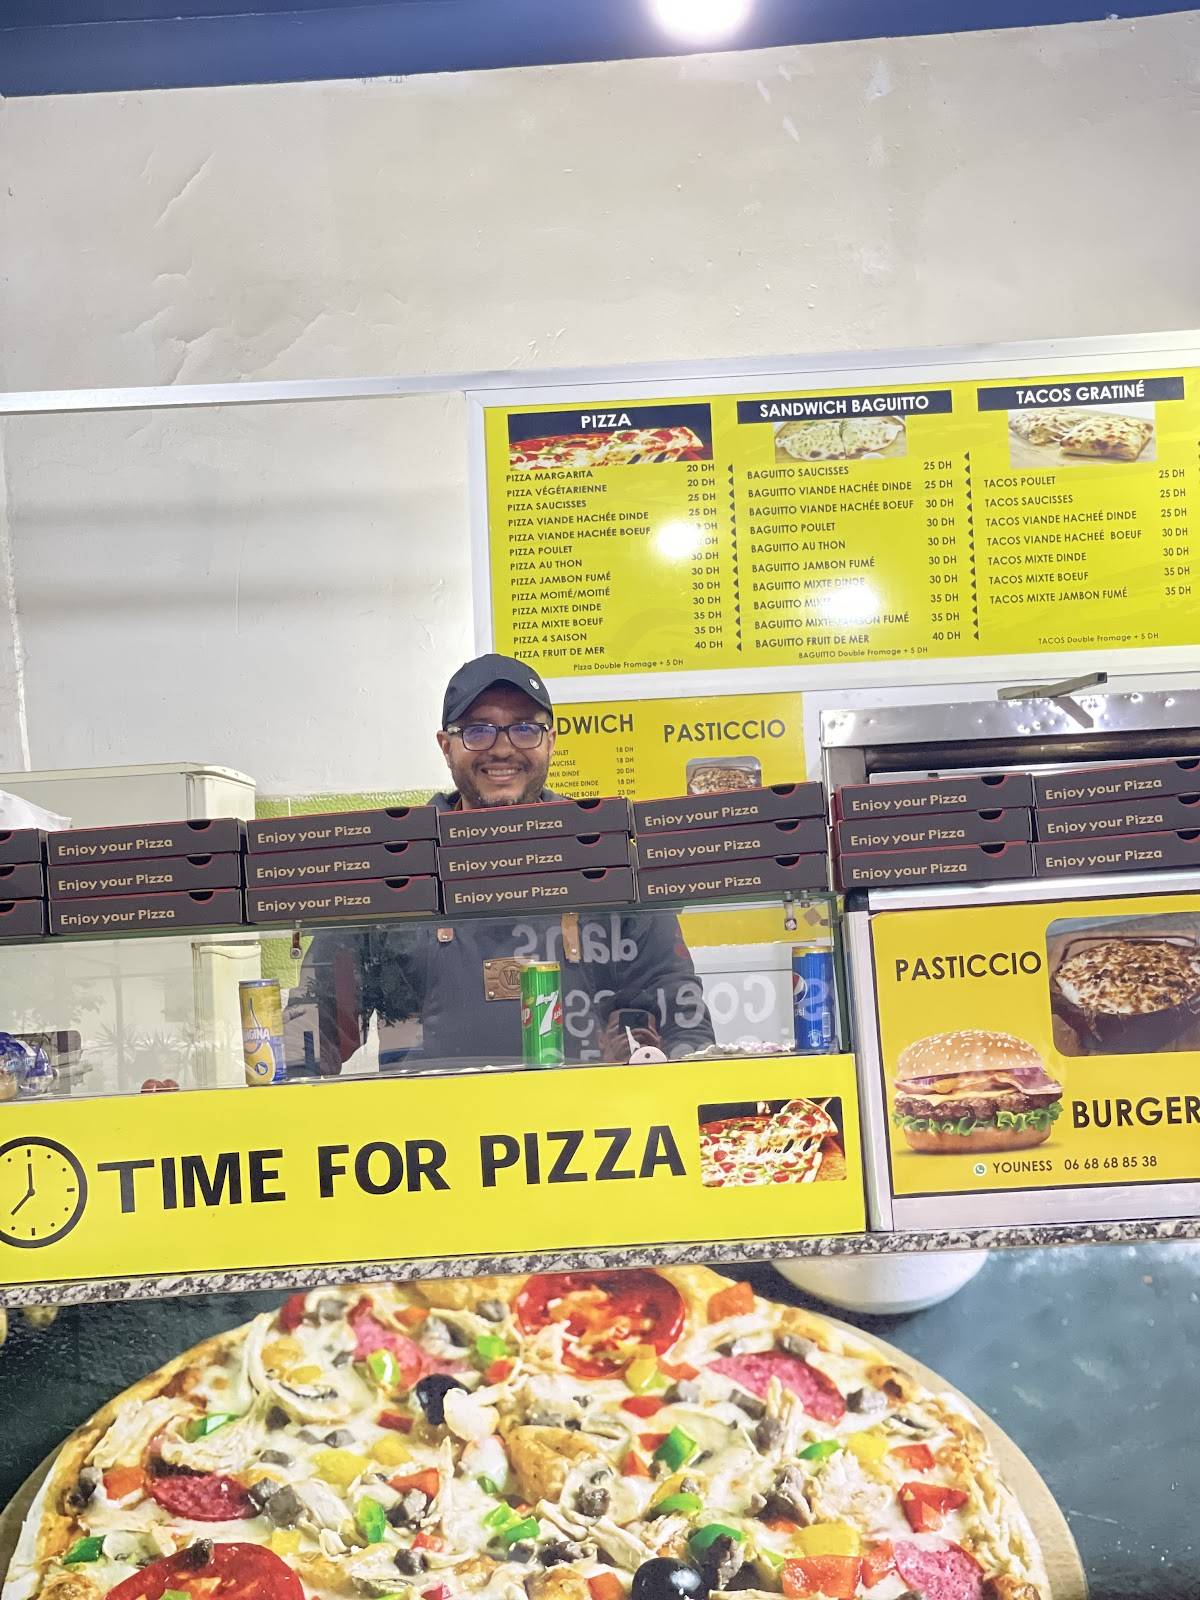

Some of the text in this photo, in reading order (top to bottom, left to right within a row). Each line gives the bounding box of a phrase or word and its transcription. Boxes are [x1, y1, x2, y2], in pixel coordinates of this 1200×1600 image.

[1016, 381, 1145, 404] TACOS GRATINÉ
[760, 395, 929, 418] SANDWICH BAGUITTO
[581, 413, 632, 429] PIZZA
[686, 463, 715, 473] 20 DH
[923, 460, 952, 471] 25 DH
[506, 470, 593, 483] PIZZA MARGARITA
[747, 466, 849, 480] BAGUITTO SAUCISSES
[748, 480, 912, 498] BAGUITTO VIANDE HACHÉE DINDE
[983, 476, 1056, 488] TACOS POULET
[506, 484, 607, 498] PIZZA VÉGÉTARIENNE
[688, 492, 716, 502] 25 DH
[507, 499, 587, 512] PIZZA SAUCISSES
[749, 499, 914, 516] BAGUITTO VIANDE HACHÉE BOEUF
[926, 498, 954, 508] 30 DH
[985, 494, 1073, 508] TACOS SAUCISSES
[508, 511, 649, 527] PIZZA VIANDE HACHÉE DINDE
[985, 516, 1020, 528] TACOS
[1022, 514, 1061, 525] VIANDE
[1106, 510, 1137, 521] DINDE
[1161, 507, 1187, 518] 25 DH
[508, 526, 650, 543] PIZZA VIANDE HACHÉE BOEUF
[750, 522, 836, 535] BAGUITTO POULET
[987, 535, 1021, 546] TACOS
[1023, 534, 1062, 544] VIANDE
[1110, 529, 1142, 540] BOEUF
[509, 545, 573, 557] PIZZA POULET
[751, 540, 846, 553] BAGUITTO AU THON
[510, 559, 582, 571] PIZZA AU THON
[752, 556, 875, 573] BAGUITTO JAMBON FUMÉ
[928, 555, 957, 566] 30 DH
[987, 552, 1087, 566] TACOS MIXTE DINDE
[510, 570, 611, 587] PIZZA JAMBON FUMÉ
[988, 571, 1089, 585] TACOS MIXTE BOEUF
[511, 586, 610, 602] PIZZA MOITIÉ/MOITIÉ
[990, 586, 1128, 605] TACOS MIXTE JAMBON FUMÉ
[1165, 586, 1191, 596] 35 DH
[512, 603, 602, 616] PIZZA MIXTE DINDE
[512, 617, 603, 630] PIZZA MIXTE BOEUF
[513, 635, 539, 645] PIZZA
[550, 632, 587, 643] SAISON
[755, 634, 869, 649] BAGUITTO FRUIT DE MER
[932, 631, 961, 641] 40 DH
[1038, 636, 1066, 645] TACOS
[1067, 634, 1095, 644] Double
[1096, 631, 1132, 643] Fromage
[1140, 632, 1146, 640] 5
[1147, 632, 1159, 640] DH
[694, 640, 723, 649] 40 DH
[513, 646, 605, 660] PIZZA FRUIT DE MER
[663, 719, 785, 743] PASTICCIO
[550, 759, 576, 767] AUCISSE
[852, 795, 967, 811] Enjoy your Pizza
[450, 820, 563, 838] Enjoy your Pizza
[1048, 815, 1163, 833] Enjoy your Pizza
[58, 839, 173, 856] Enjoy your Pizza
[647, 840, 760, 859] Enjoy your Pizza
[895, 951, 1041, 982] PASTICCIO
[98, 1126, 686, 1213] TIME FOR PIZZA
[993, 1155, 1157, 1174] YOUNESS 06 68 68 85 38
